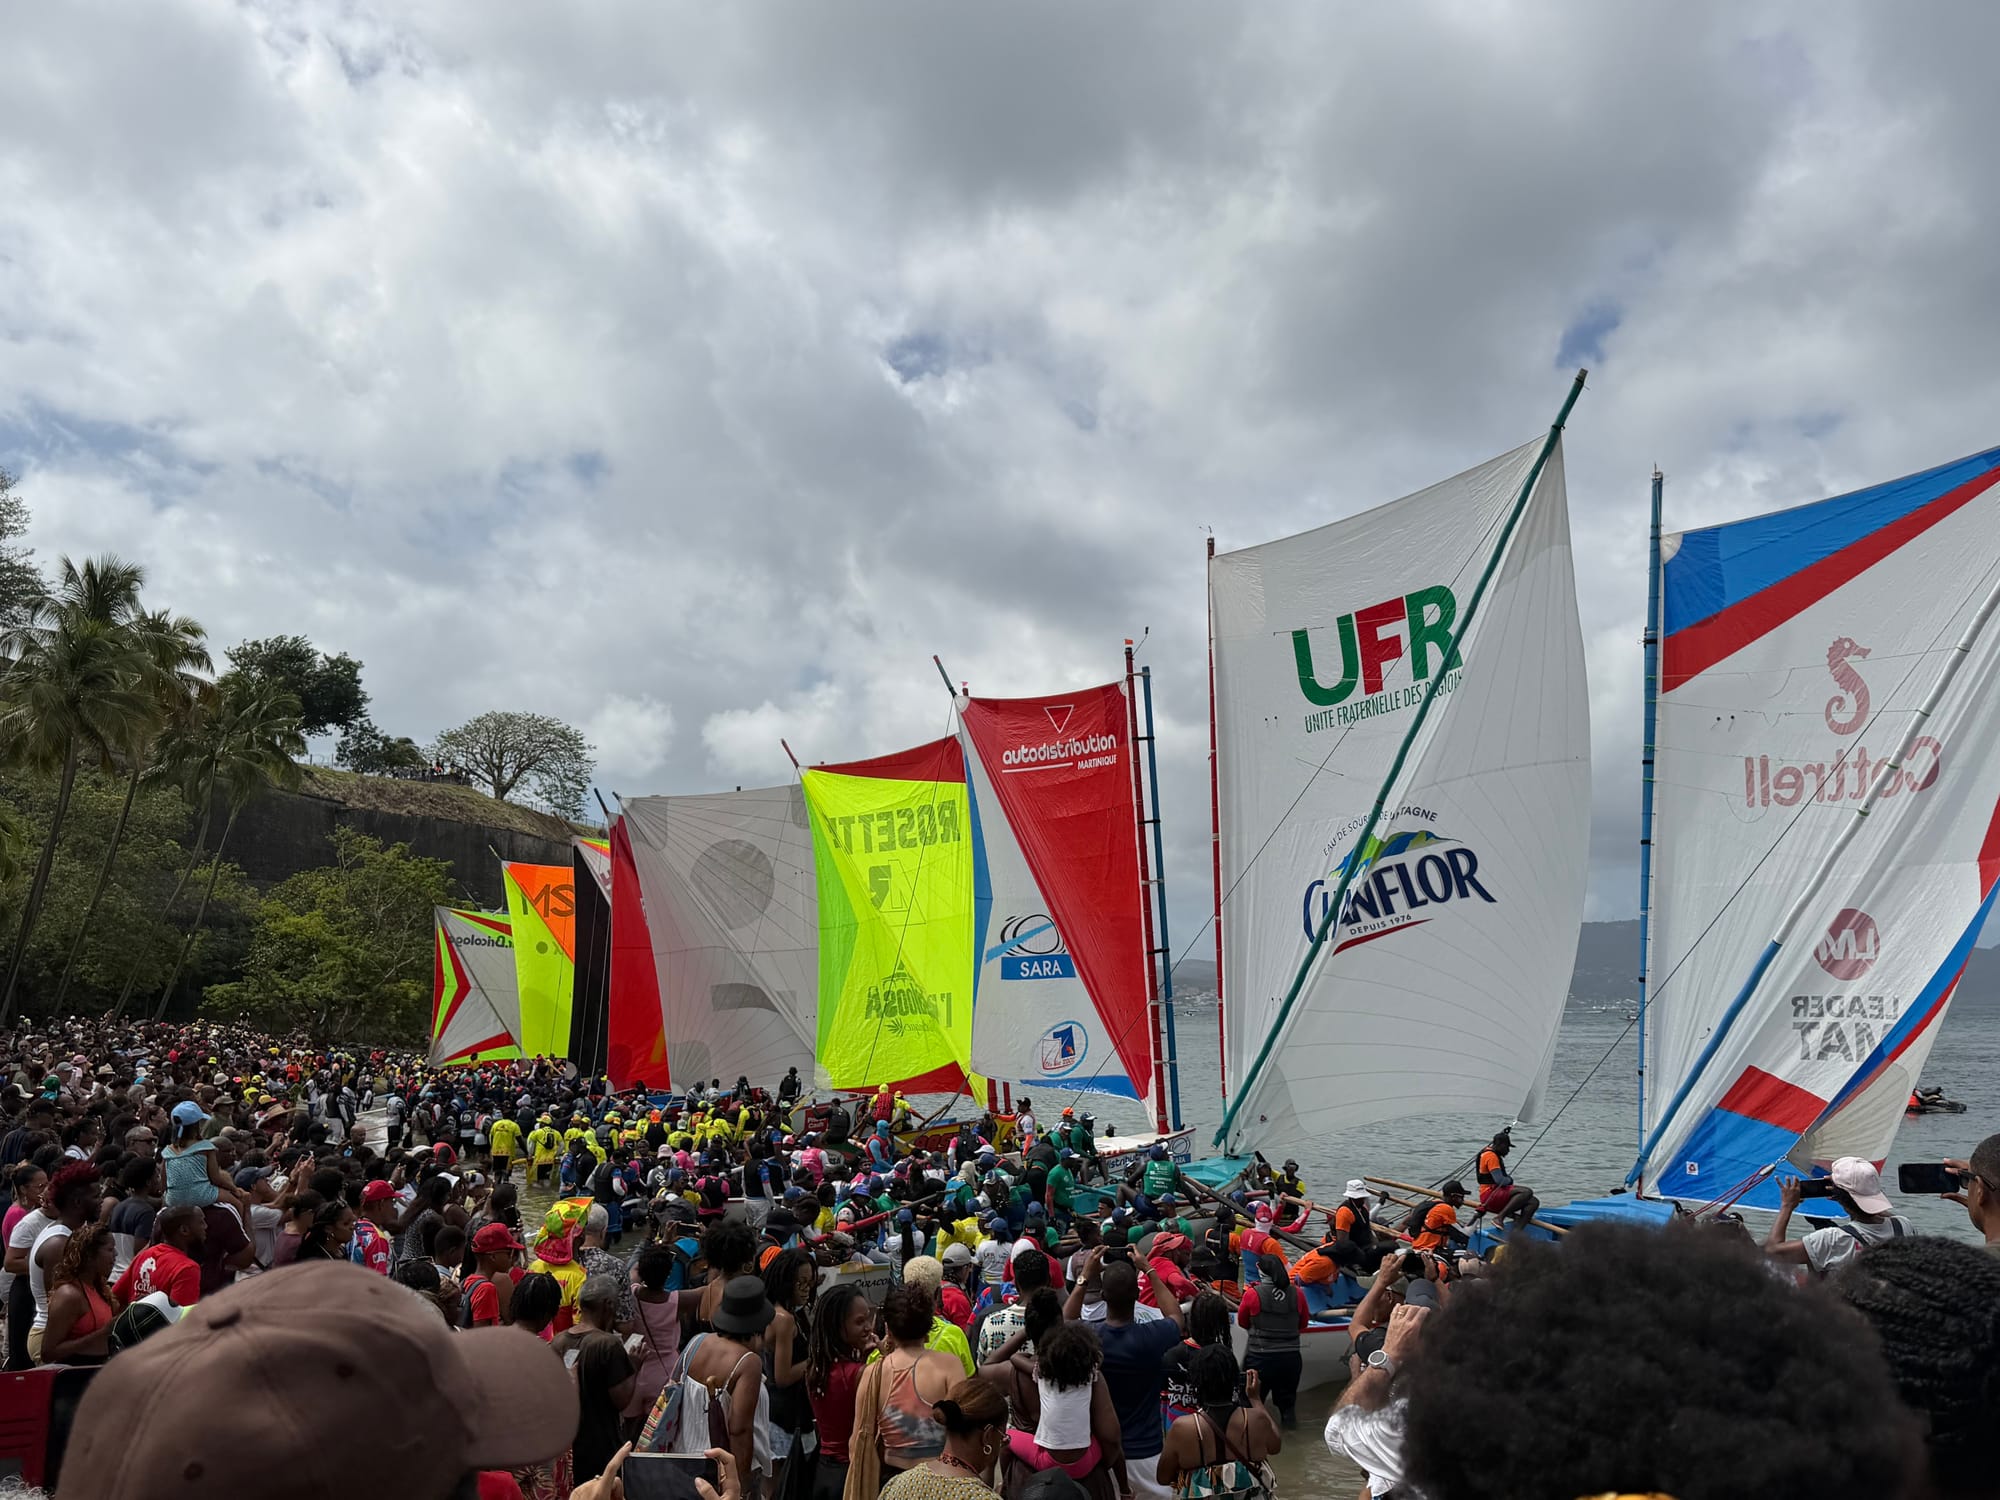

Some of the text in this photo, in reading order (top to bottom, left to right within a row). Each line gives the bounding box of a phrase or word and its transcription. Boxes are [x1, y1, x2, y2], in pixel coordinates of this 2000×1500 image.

[1292, 584, 1464, 707] UFR
[1305, 709, 1334, 734] UNITE
[1337, 690, 1401, 727] FRATERNELLE
[1403, 684, 1422, 707] DES
[1002, 733, 1117, 765] autodistribution
[1077, 754, 1118, 770] MARTINIQUE
[1337, 827, 1347, 841] DE
[1350, 913, 1413, 936] DEPUIS 1976
[1020, 959, 1063, 977] SARA
